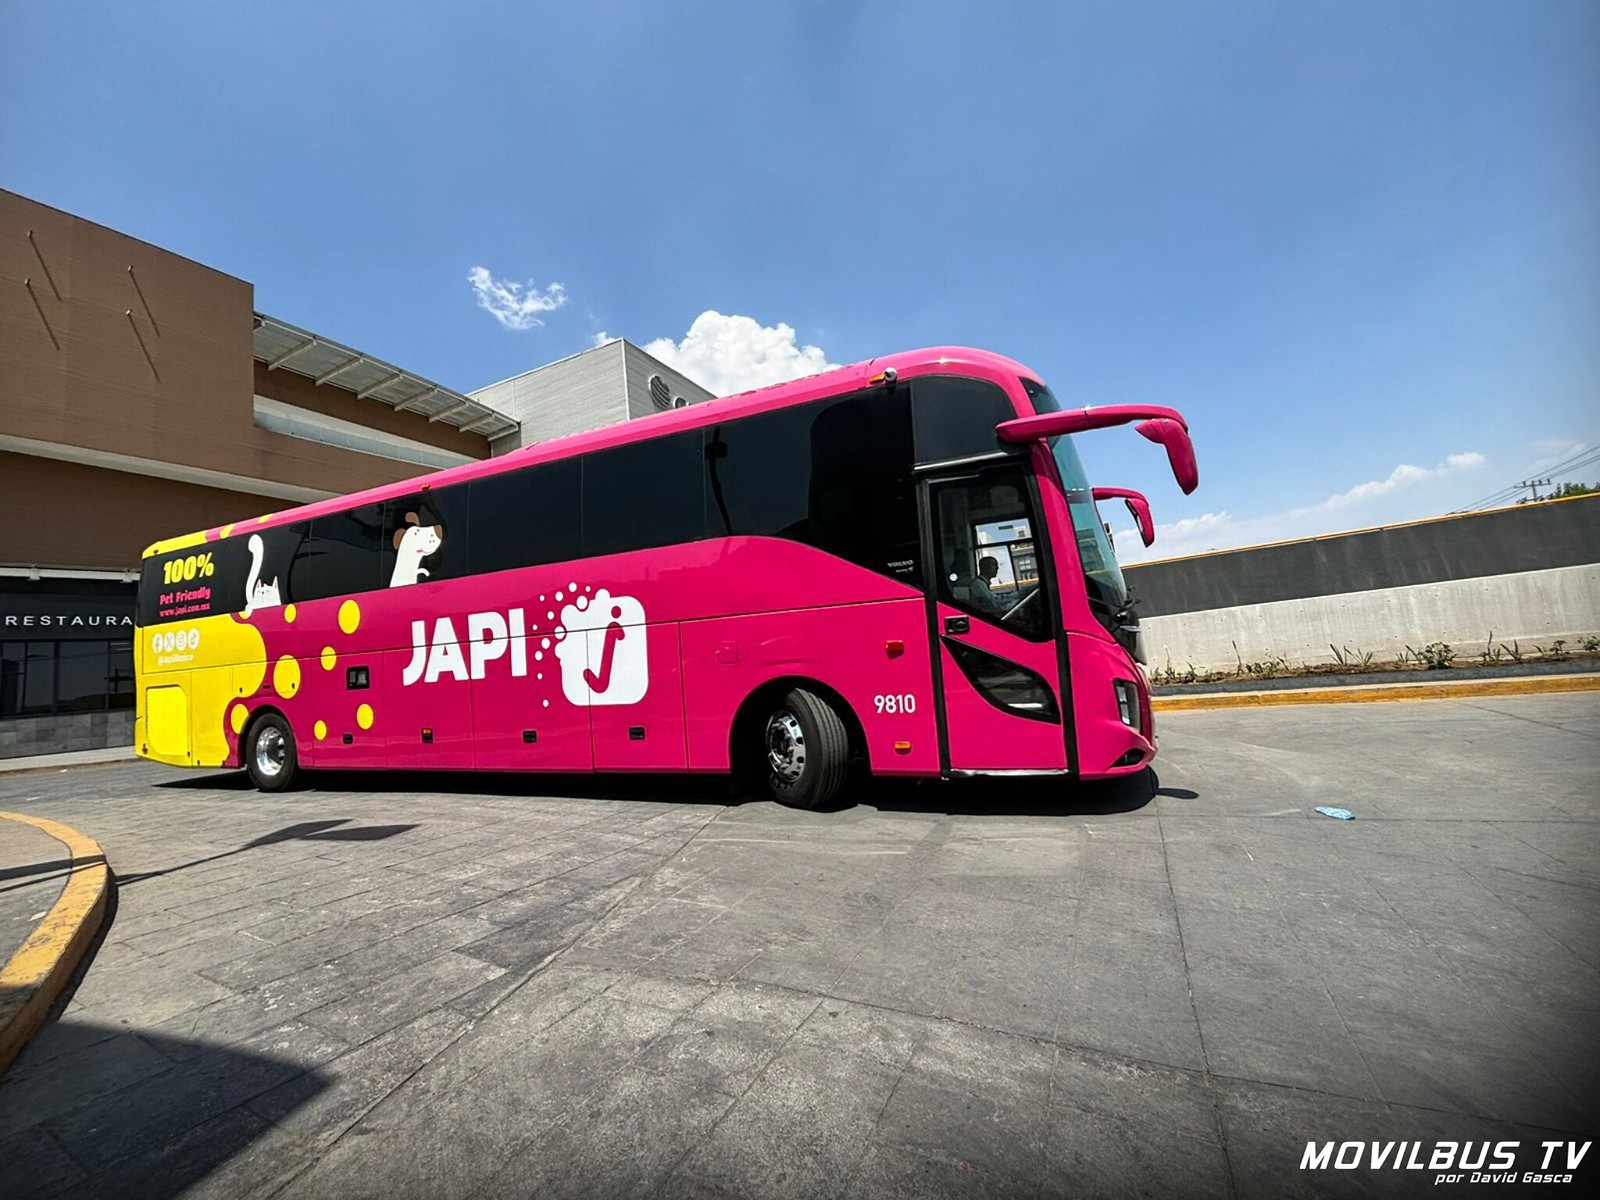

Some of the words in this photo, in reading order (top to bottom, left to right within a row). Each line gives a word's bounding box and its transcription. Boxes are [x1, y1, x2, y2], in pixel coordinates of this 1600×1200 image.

[164, 552, 214, 584] 100%
[160, 593, 173, 605] Pet
[176, 587, 211, 602] Friendly
[403, 608, 527, 686] JAPI
[874, 694, 916, 714] 9810
